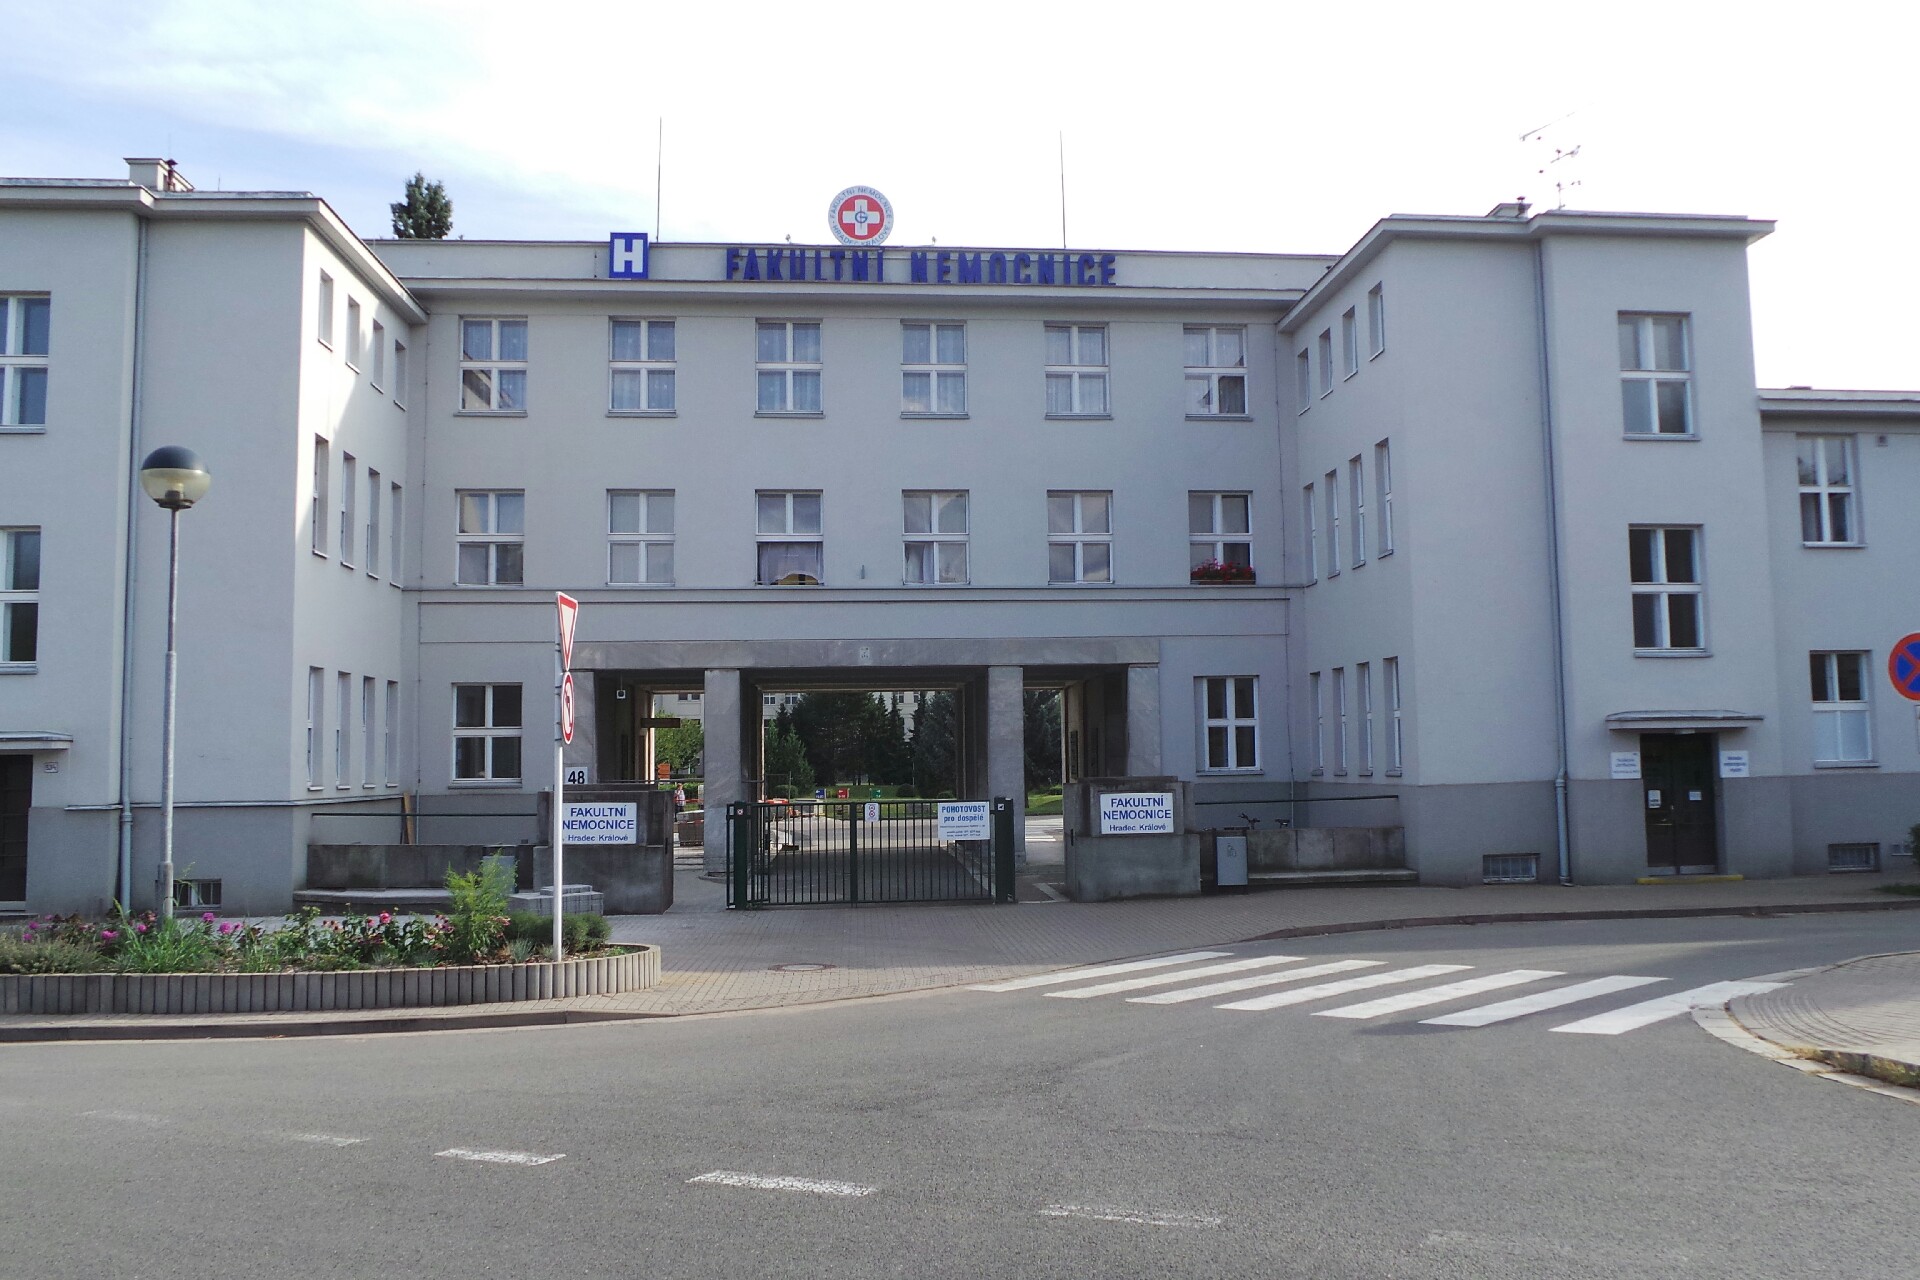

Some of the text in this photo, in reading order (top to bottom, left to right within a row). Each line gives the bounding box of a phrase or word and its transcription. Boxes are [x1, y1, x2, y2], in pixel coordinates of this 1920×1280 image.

[614, 239, 643, 273] H
[911, 251, 1117, 286] NEMOCNICE
[568, 770, 585, 784] 48
[1111, 795, 1164, 808] FAKULTNÍ
[570, 804, 627, 817] FAKULTNÍ
[941, 805, 986, 813] POHOTOVOST
[1103, 809, 1172, 820] NEMOCNICE
[943, 813, 984, 823] pro dospělé
[562, 820, 635, 830] NEMOCNICE
[1109, 823, 1167, 832] Hradec Králové
[568, 834, 629, 842] Hradec Králové
